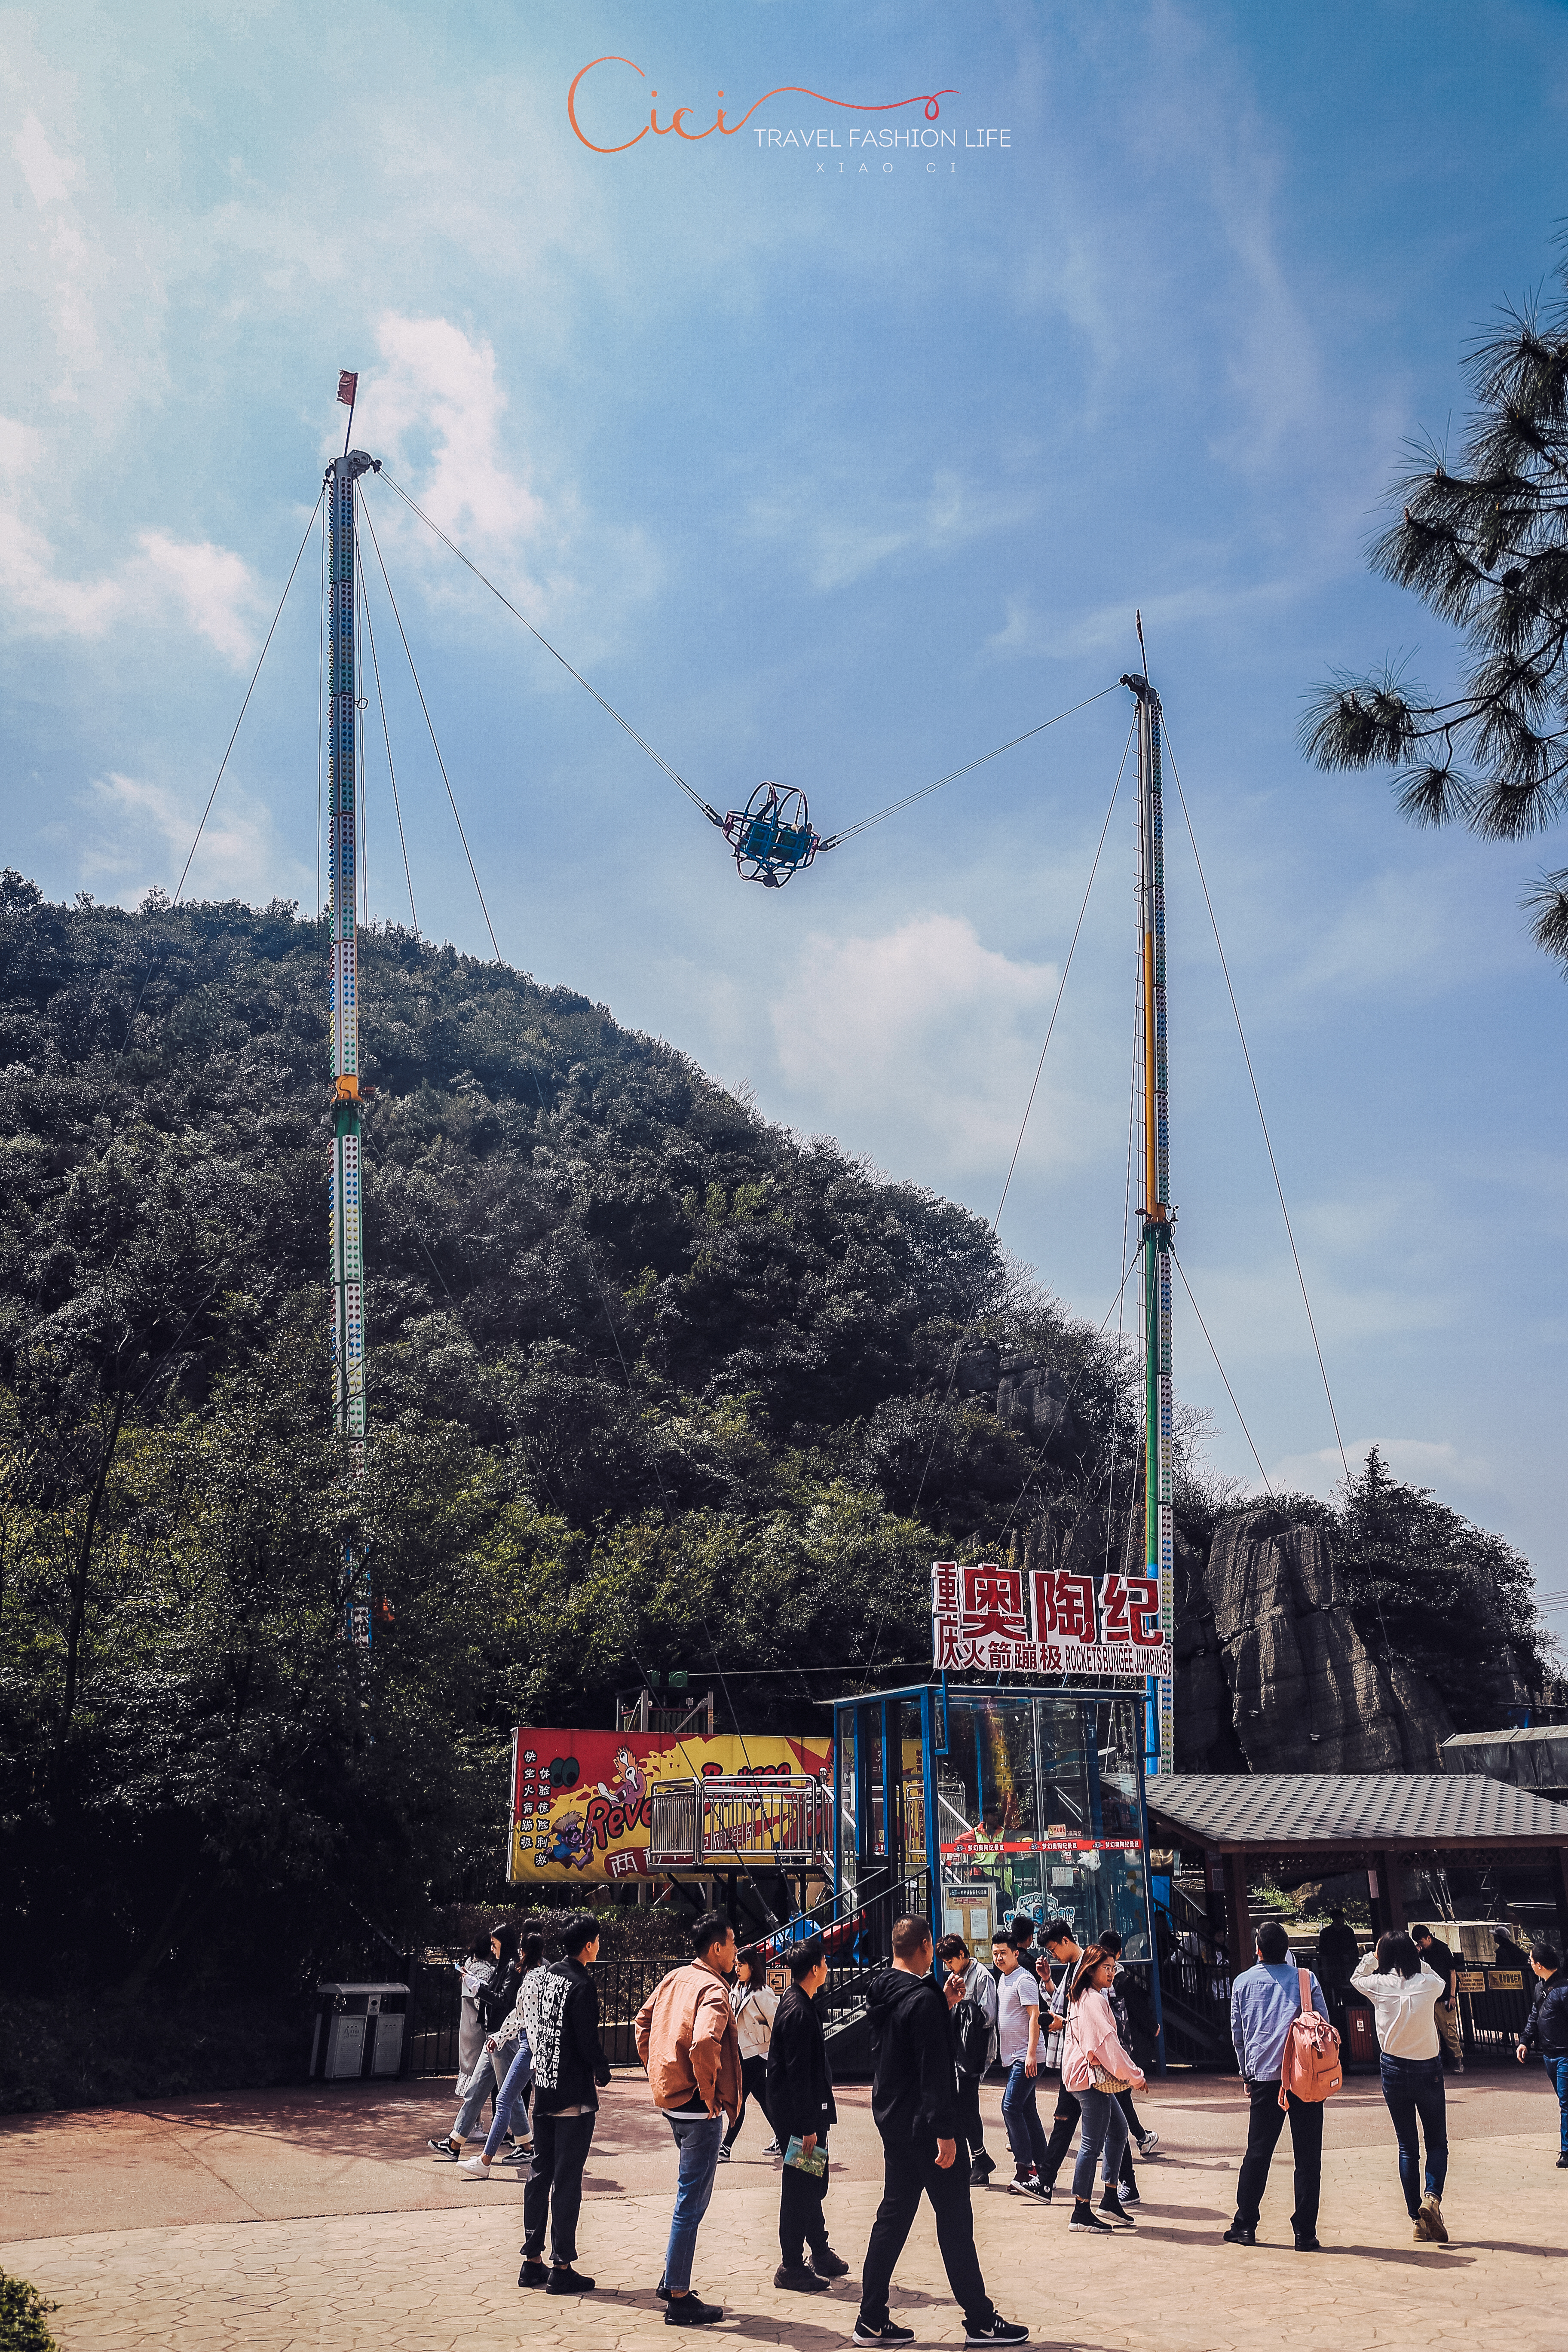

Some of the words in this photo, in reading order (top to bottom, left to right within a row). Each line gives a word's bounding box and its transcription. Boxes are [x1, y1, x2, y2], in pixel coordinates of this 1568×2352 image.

[934, 1562, 960, 1669] 重庆
[961, 1564, 1165, 1646] 奥陶纪
[963, 1641, 1063, 1671] 火箭蹦极
[1135, 1648, 1168, 1675] JUMPING
